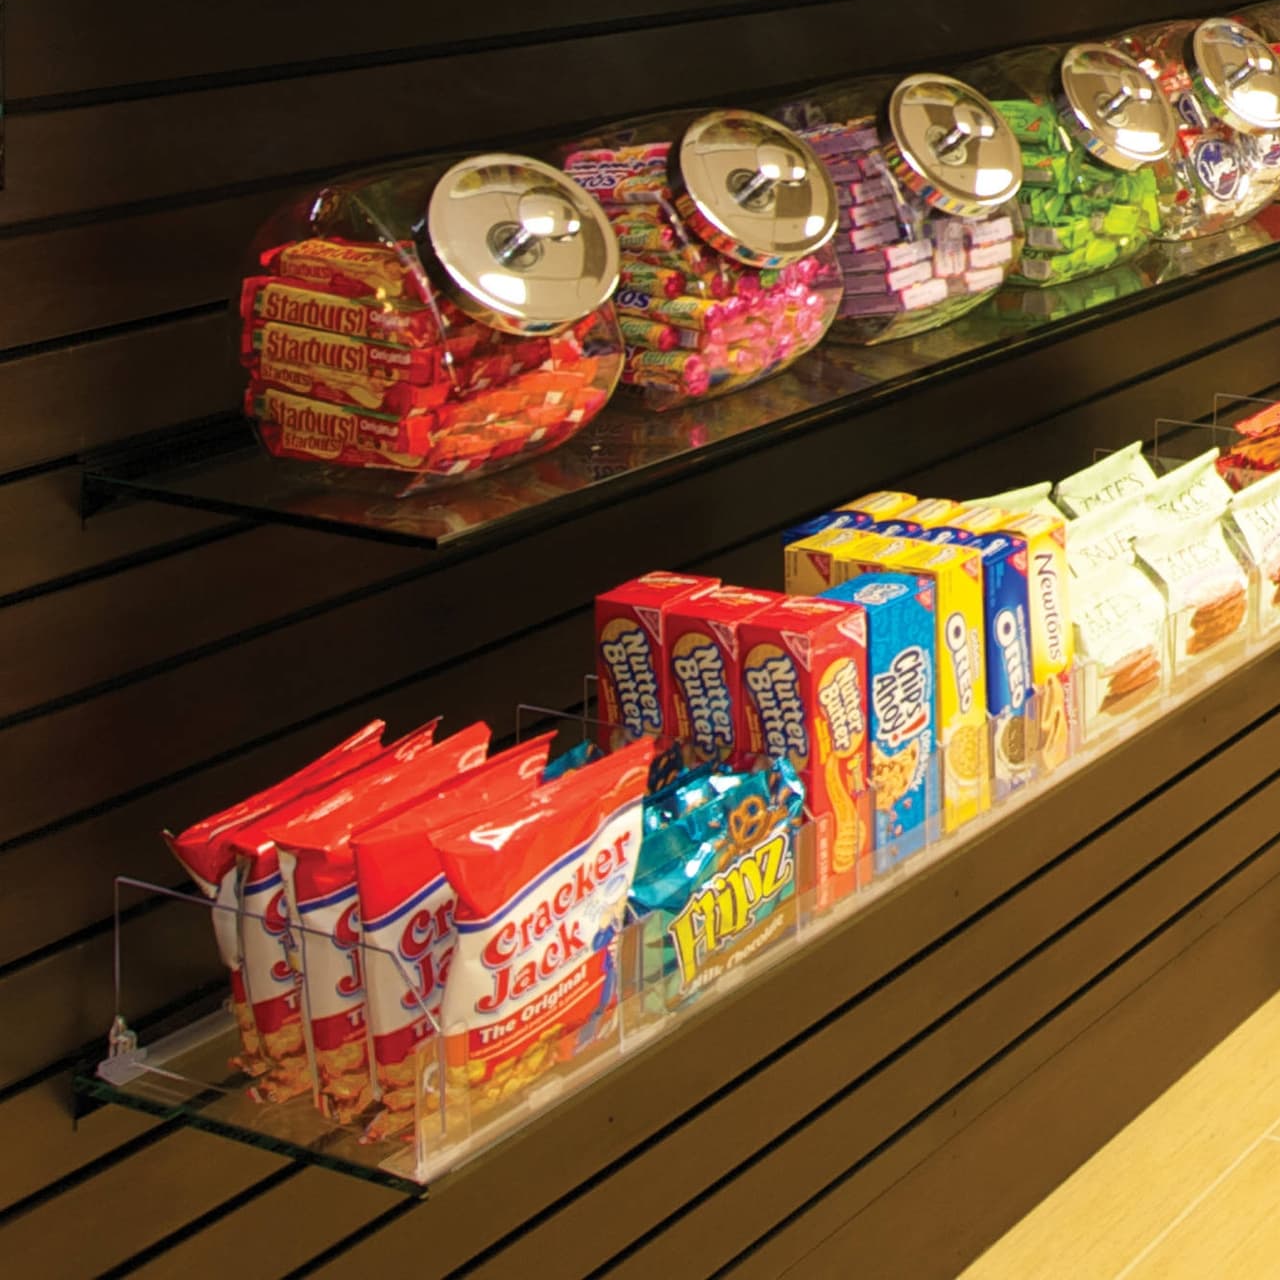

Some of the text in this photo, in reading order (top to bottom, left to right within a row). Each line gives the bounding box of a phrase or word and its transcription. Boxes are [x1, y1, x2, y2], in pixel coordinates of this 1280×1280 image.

[266, 292, 367, 335] Starburst
[266, 330, 367, 372] Starburst
[268, 396, 358, 443] Starburst
[1034, 552, 1063, 662] Newtons
[603, 644, 643, 737] Butter
[623, 631, 661, 728] Nutter
[674, 658, 714, 755] Butter
[695, 646, 733, 744] Nutter
[836, 660, 864, 733] Nutter
[893, 648, 924, 720] Chips
[945, 612, 972, 715] OREO
[995, 609, 1026, 709] OREO
[747, 670, 786, 758] Butter
[767, 657, 807, 757] Nutter
[820, 685, 849, 751] Butter
[480, 829, 632, 969] Cracker
[476, 916, 588, 1015] Jack
[479, 963, 589, 1045] The Original
